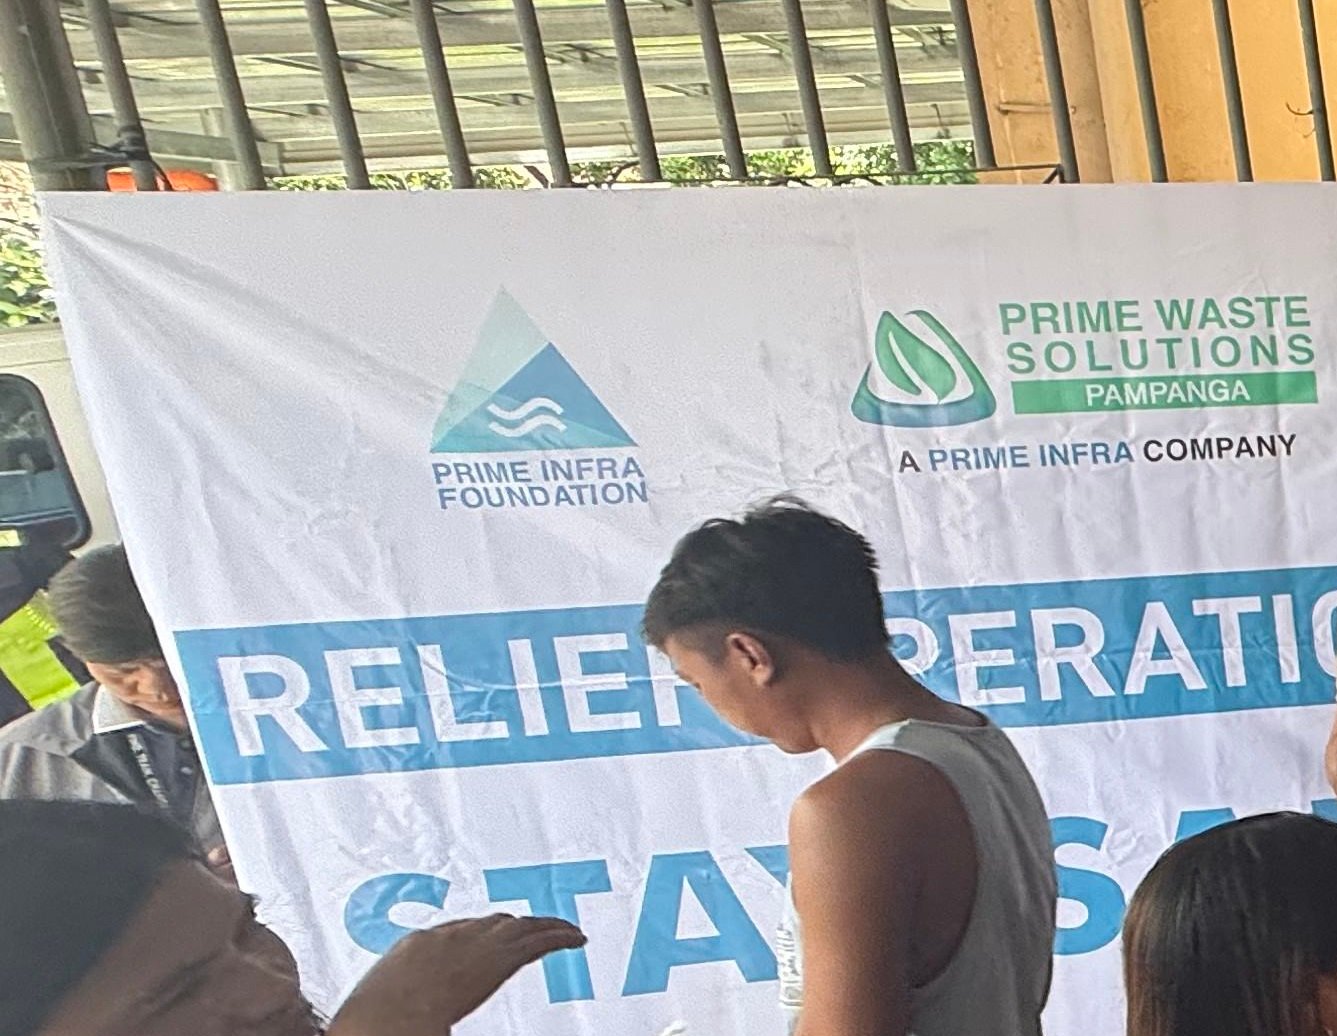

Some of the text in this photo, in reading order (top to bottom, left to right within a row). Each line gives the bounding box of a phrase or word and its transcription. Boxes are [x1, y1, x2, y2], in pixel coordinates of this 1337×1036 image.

[1000, 296, 1312, 335] PRIME WASTE
[1007, 333, 1316, 374] SOLUTIONS
[1085, 378, 1251, 407] PAMPANGA
[431, 456, 645, 485] PRIME INFRA
[898, 433, 1298, 474] A PRIME INFRA COMPANY
[438, 481, 649, 510] FOUNDATION
[343, 843, 790, 1005] STA
